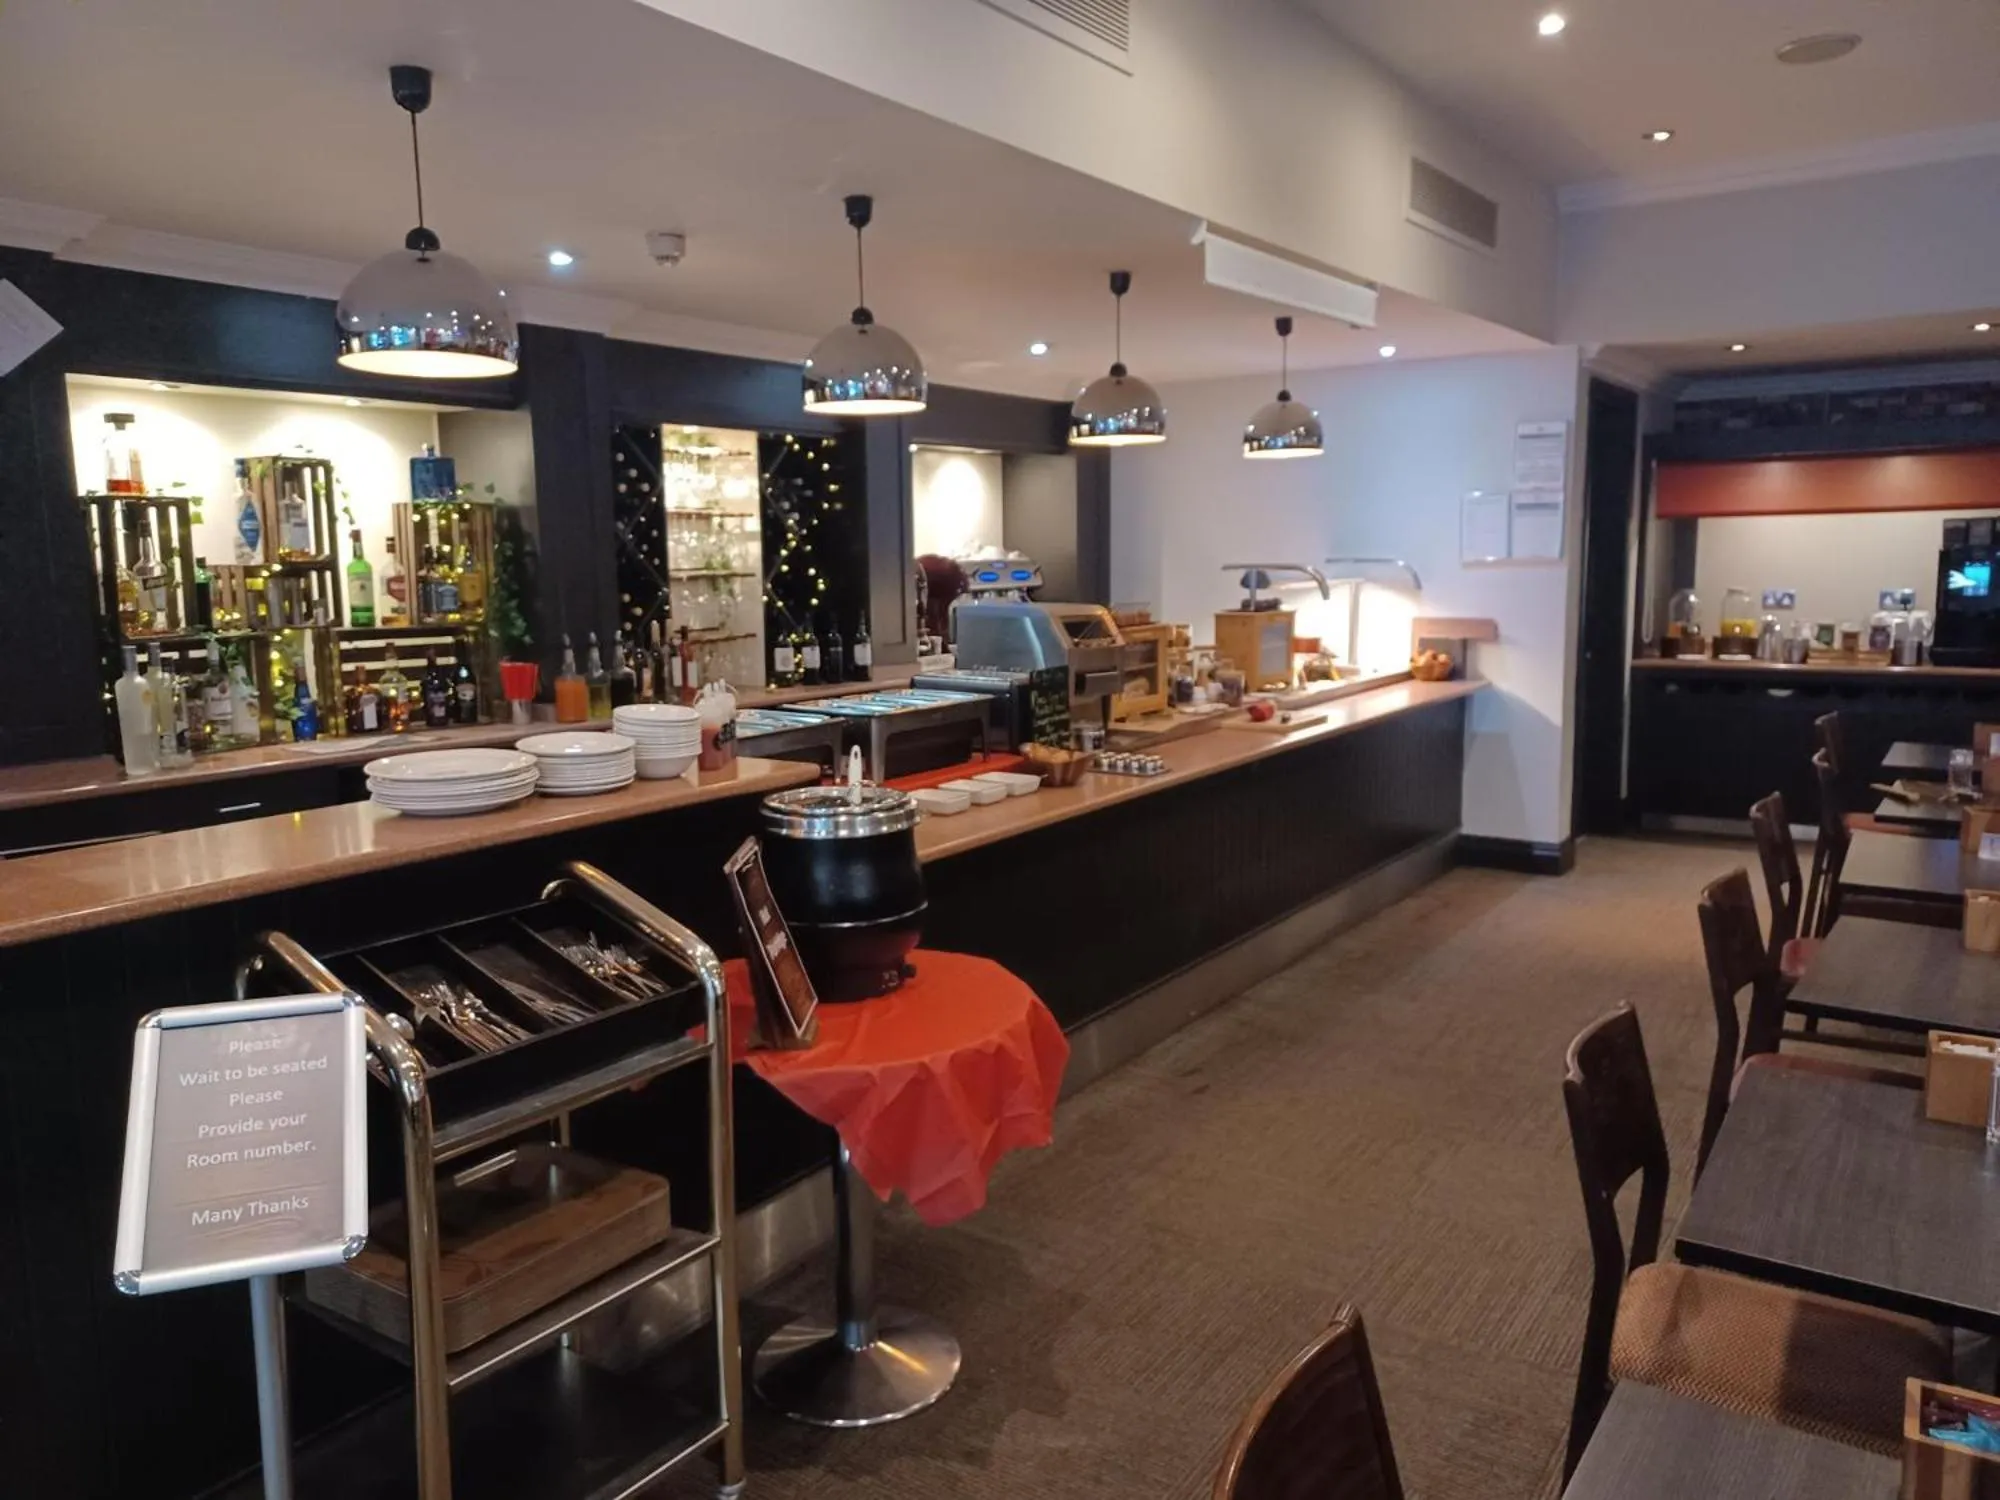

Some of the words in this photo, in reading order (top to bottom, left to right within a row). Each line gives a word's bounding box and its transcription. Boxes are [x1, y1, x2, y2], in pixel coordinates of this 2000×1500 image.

[229, 1036, 283, 1054] Please
[179, 1069, 221, 1087] Wait
[225, 1066, 243, 1081] to
[247, 1061, 268, 1078] be
[273, 1056, 328, 1075] seated
[229, 1088, 284, 1107] Please
[198, 1118, 263, 1139] Provide
[268, 1112, 308, 1136] your
[187, 1149, 239, 1169] Room
[244, 1139, 317, 1160] number.
[191, 1203, 243, 1227] Many
[247, 1195, 309, 1217] Thanks
